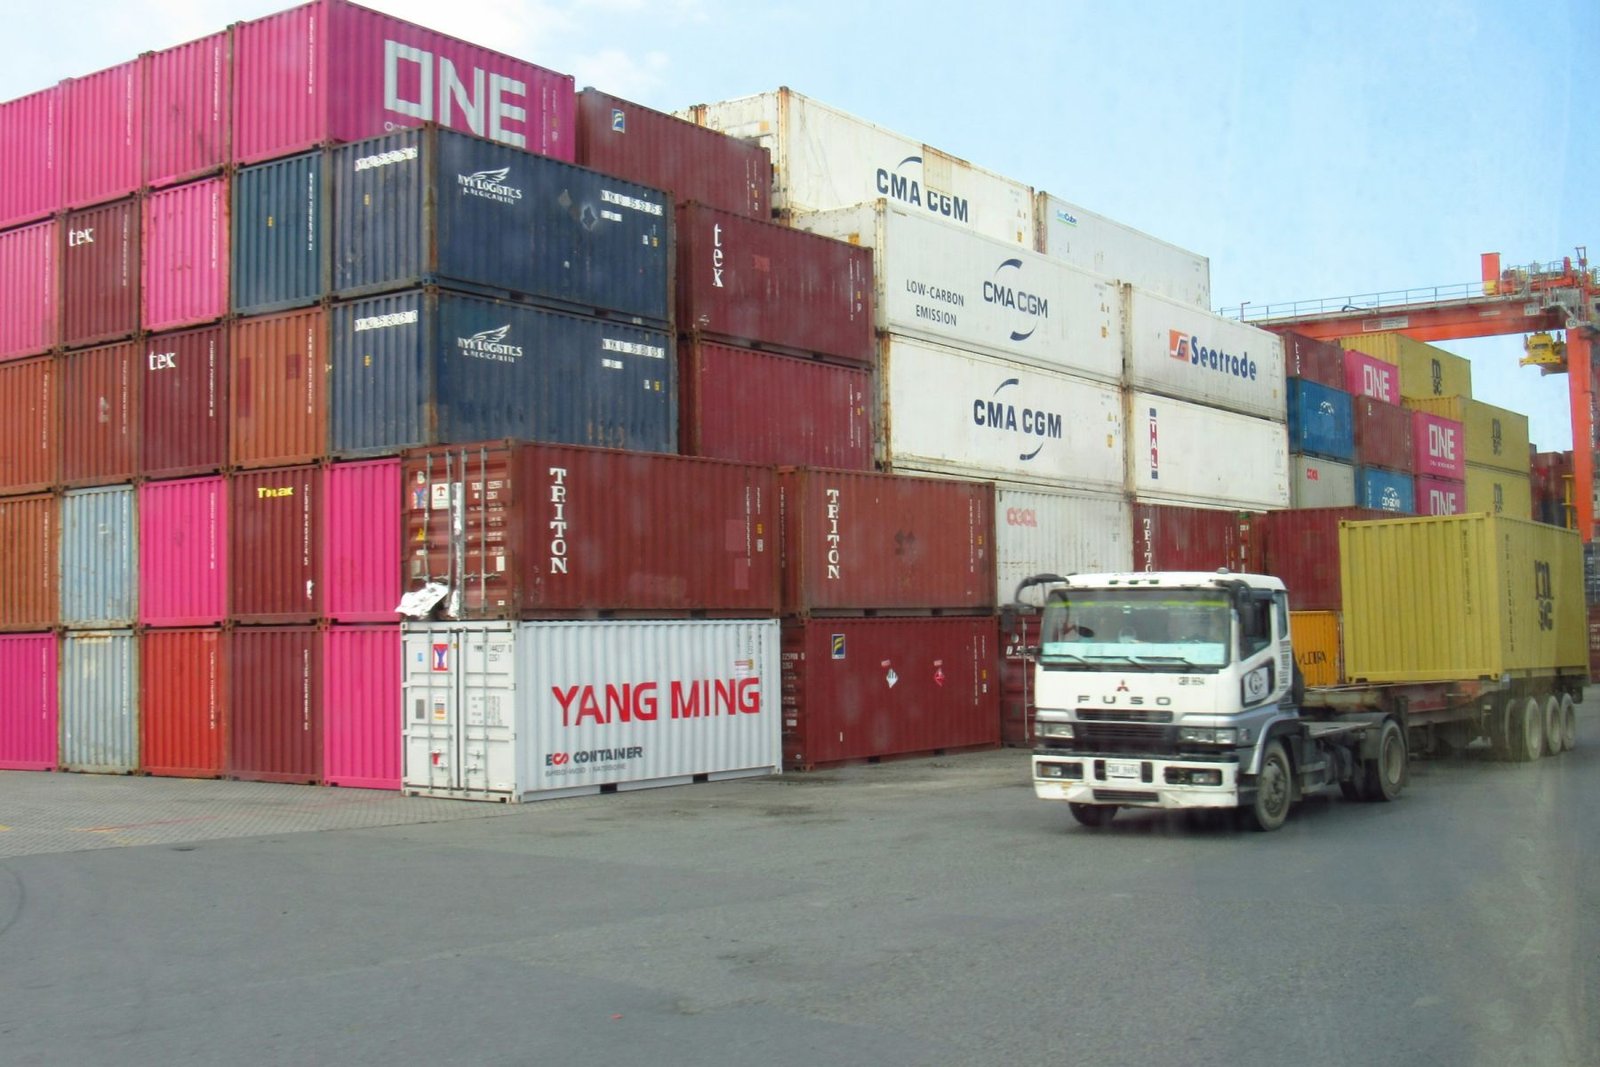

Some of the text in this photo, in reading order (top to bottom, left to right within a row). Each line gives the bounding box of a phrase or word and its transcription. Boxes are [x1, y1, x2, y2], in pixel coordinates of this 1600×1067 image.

[384, 39, 526, 149] ONE
[876, 168, 969, 223] CMA CGM
[68, 228, 95, 247] tex
[713, 223, 725, 288] tex
[906, 279, 965, 307] LOW-CARBON
[983, 281, 1049, 318] CMA CGM
[916, 304, 958, 326] EMISSION
[1191, 335, 1257, 380] Seatrade
[1363, 364, 1391, 402] ONE
[973, 399, 1062, 439] CMA CGM
[1429, 424, 1456, 460] ONE
[550, 467, 568, 574] TRITON
[826, 489, 840, 579] TRITON
[1143, 518, 1153, 573] TRITO
[552, 682, 658, 727] YANG
[670, 677, 760, 719] MING
[1077, 695, 1171, 706] FUSO
[573, 746, 643, 764] CONTAINER
